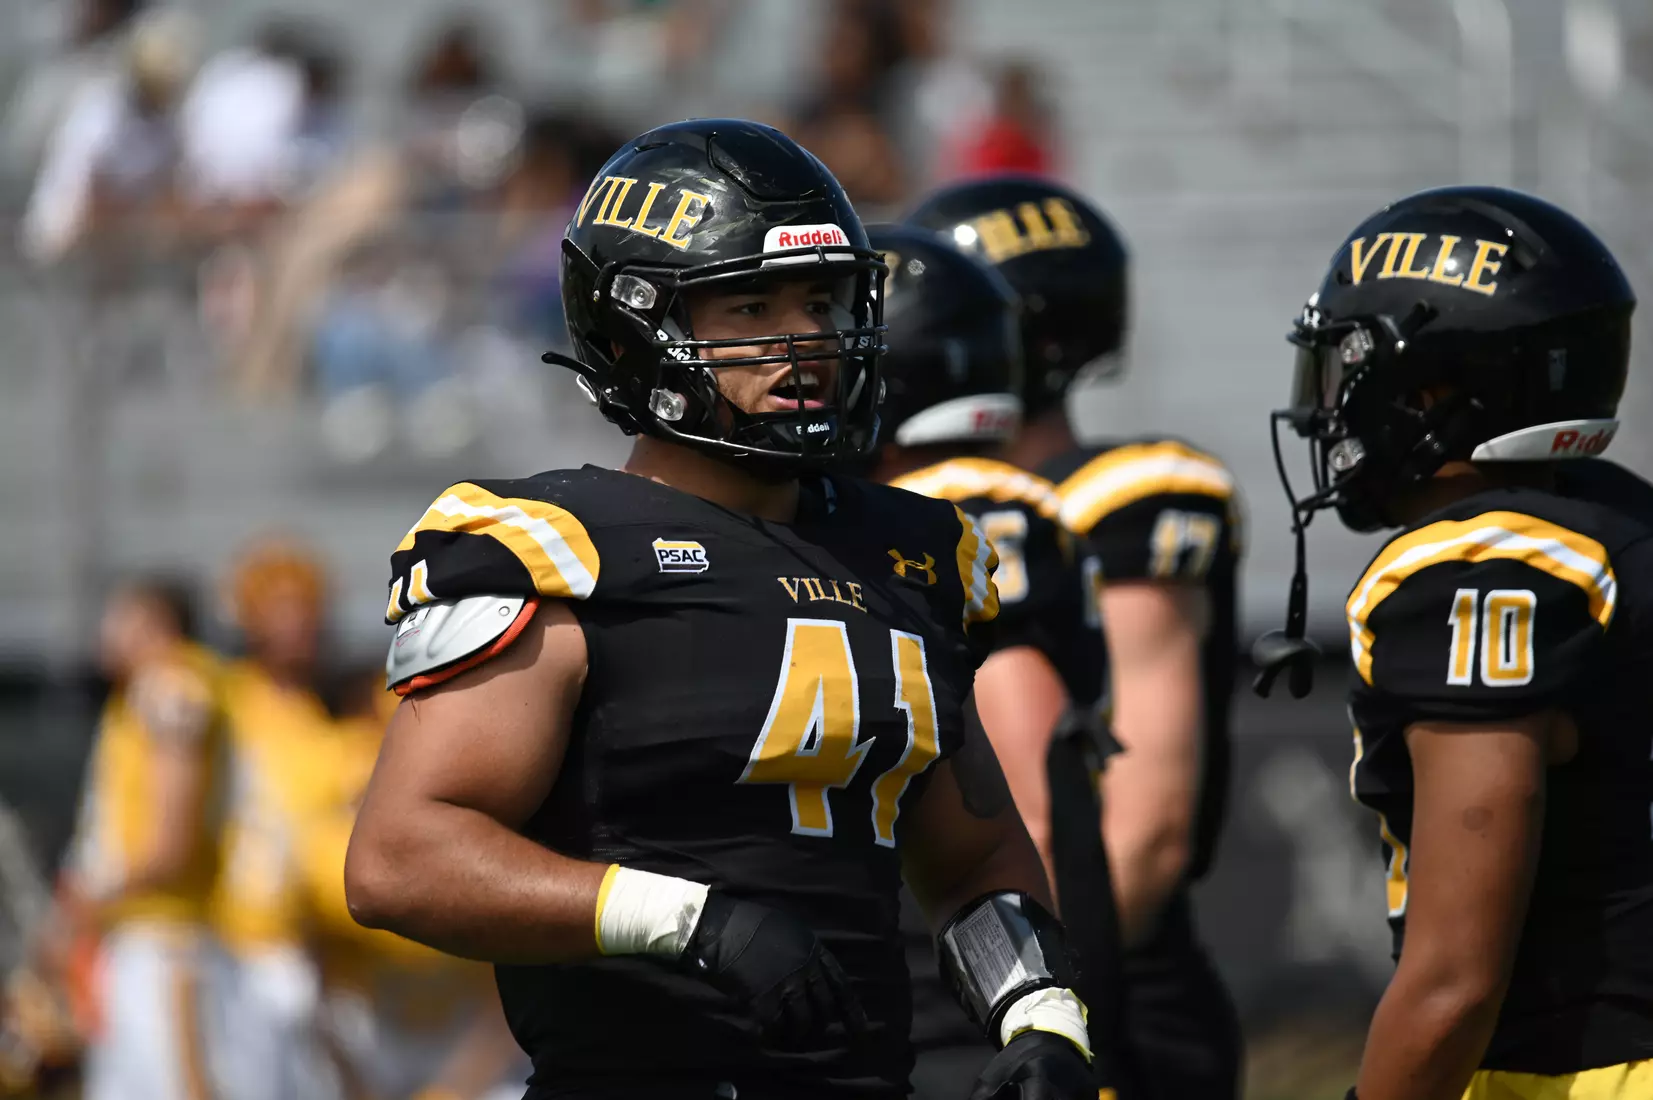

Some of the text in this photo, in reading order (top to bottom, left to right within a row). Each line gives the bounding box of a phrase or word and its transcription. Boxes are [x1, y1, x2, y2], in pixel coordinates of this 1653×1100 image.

[577, 175, 712, 249] VILLE
[779, 229, 842, 247] Riddell
[1350, 232, 1508, 295] VILLE
[795, 422, 830, 435] Rddell
[657, 549, 705, 563] PSAC
[777, 576, 868, 613] VILLE
[1447, 588, 1538, 687] 10
[735, 617, 941, 849] 41
